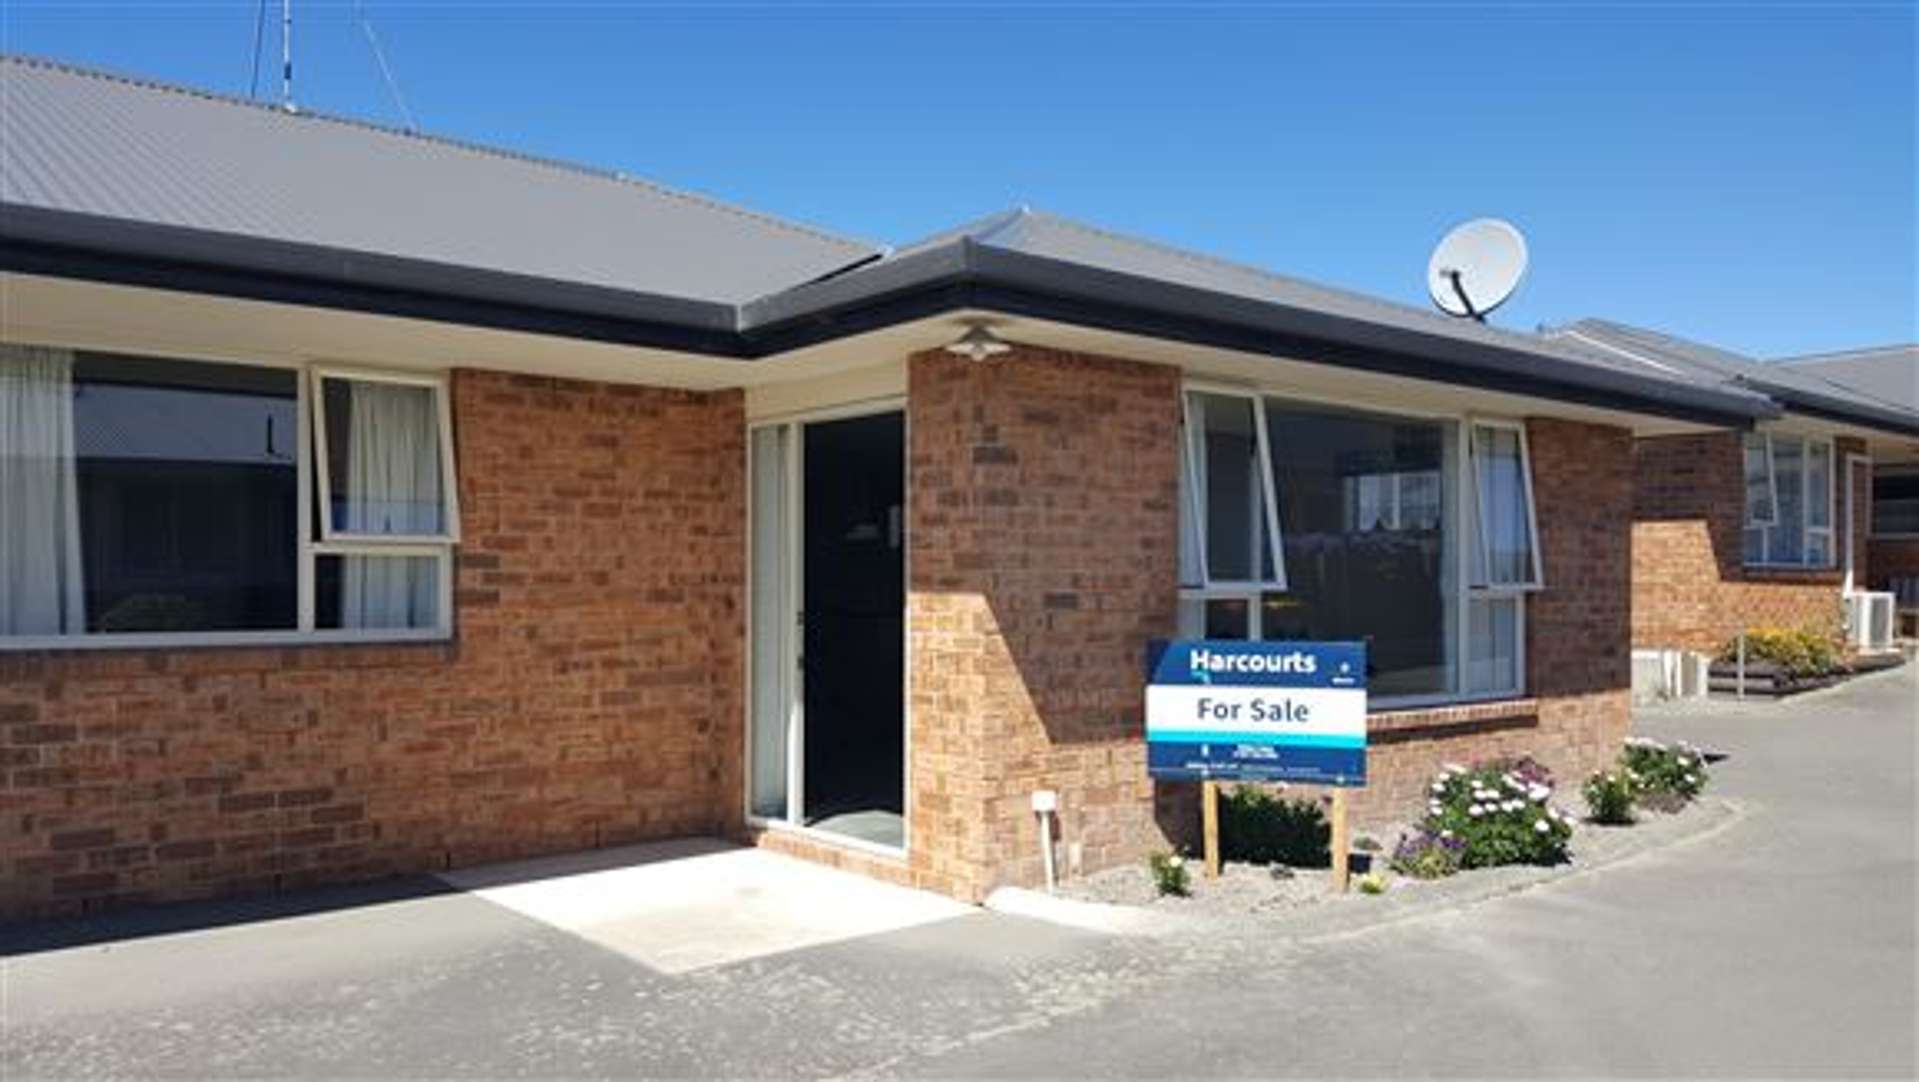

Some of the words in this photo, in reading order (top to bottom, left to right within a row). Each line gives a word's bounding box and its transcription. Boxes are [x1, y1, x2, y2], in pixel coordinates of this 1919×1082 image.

[1190, 649, 1317, 673] Harcourts
[1197, 698, 1242, 720] For
[1251, 698, 1309, 722] Sale
